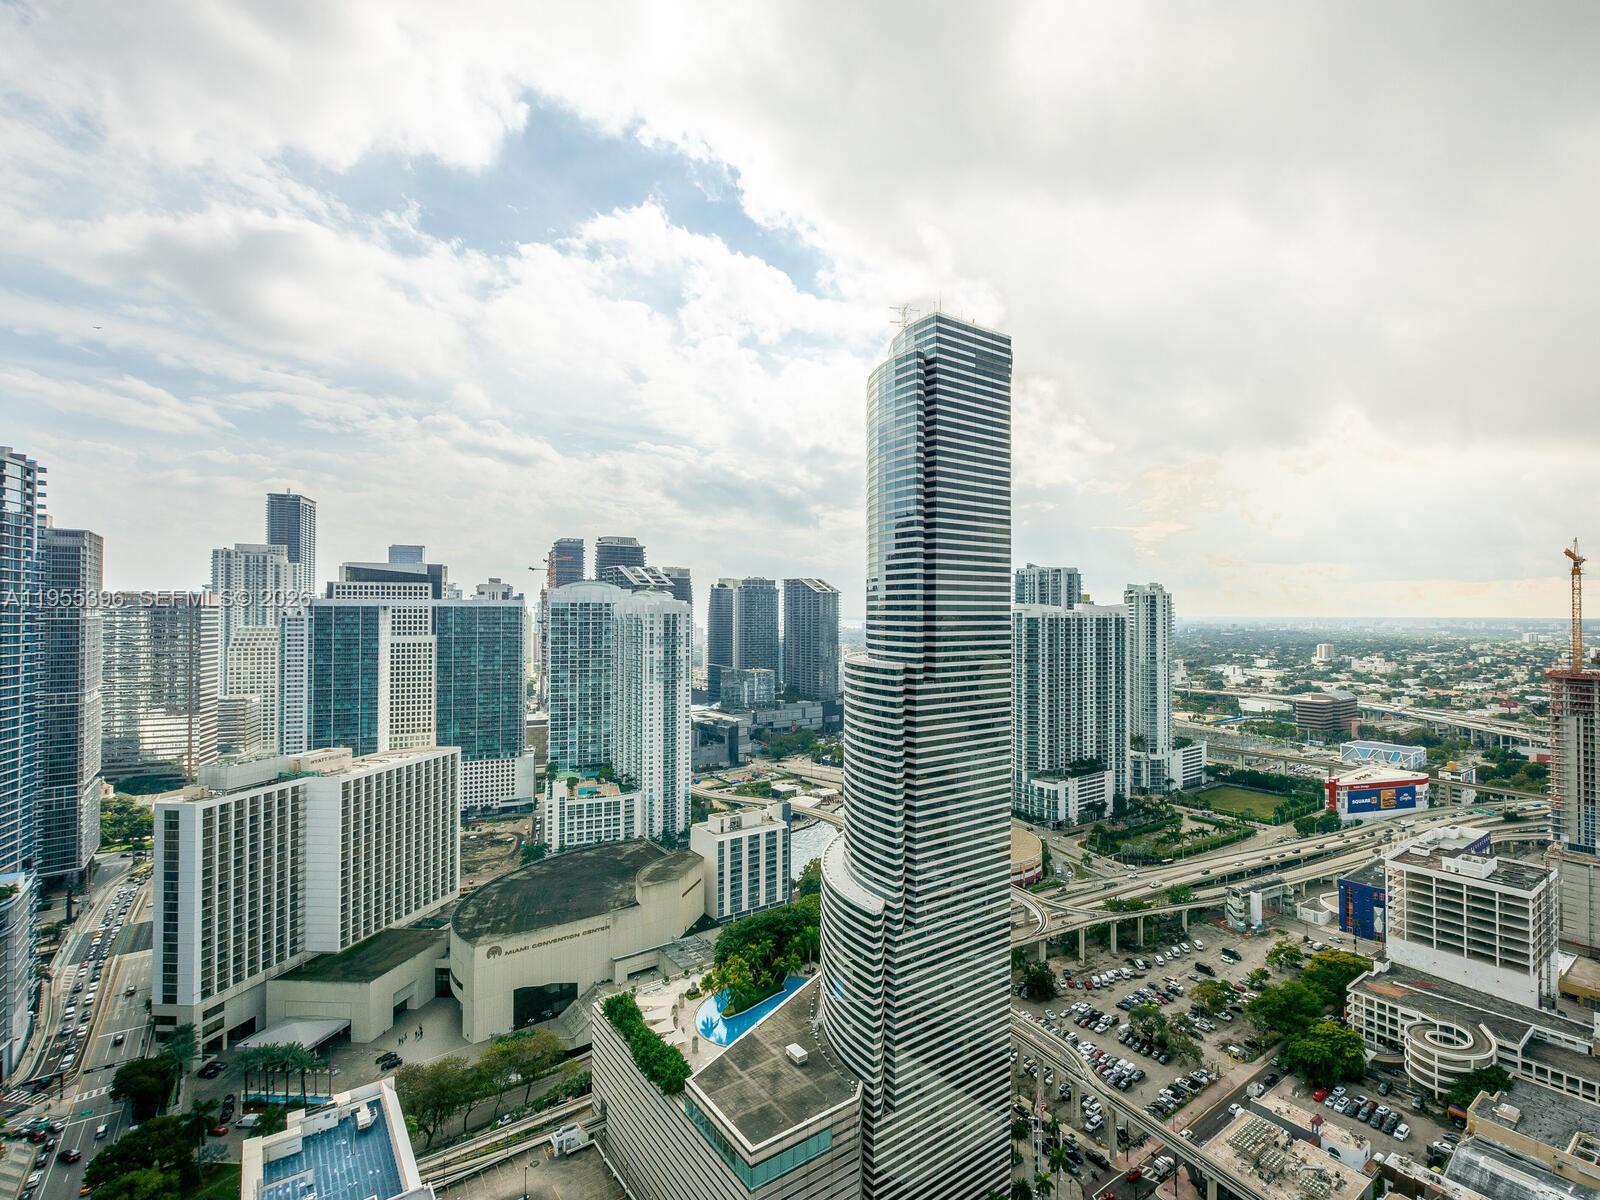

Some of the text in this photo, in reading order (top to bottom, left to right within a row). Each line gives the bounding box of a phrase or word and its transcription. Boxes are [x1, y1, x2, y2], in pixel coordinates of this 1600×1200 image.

[504, 925, 610, 956] MIAMI CONVENTION CENTER
